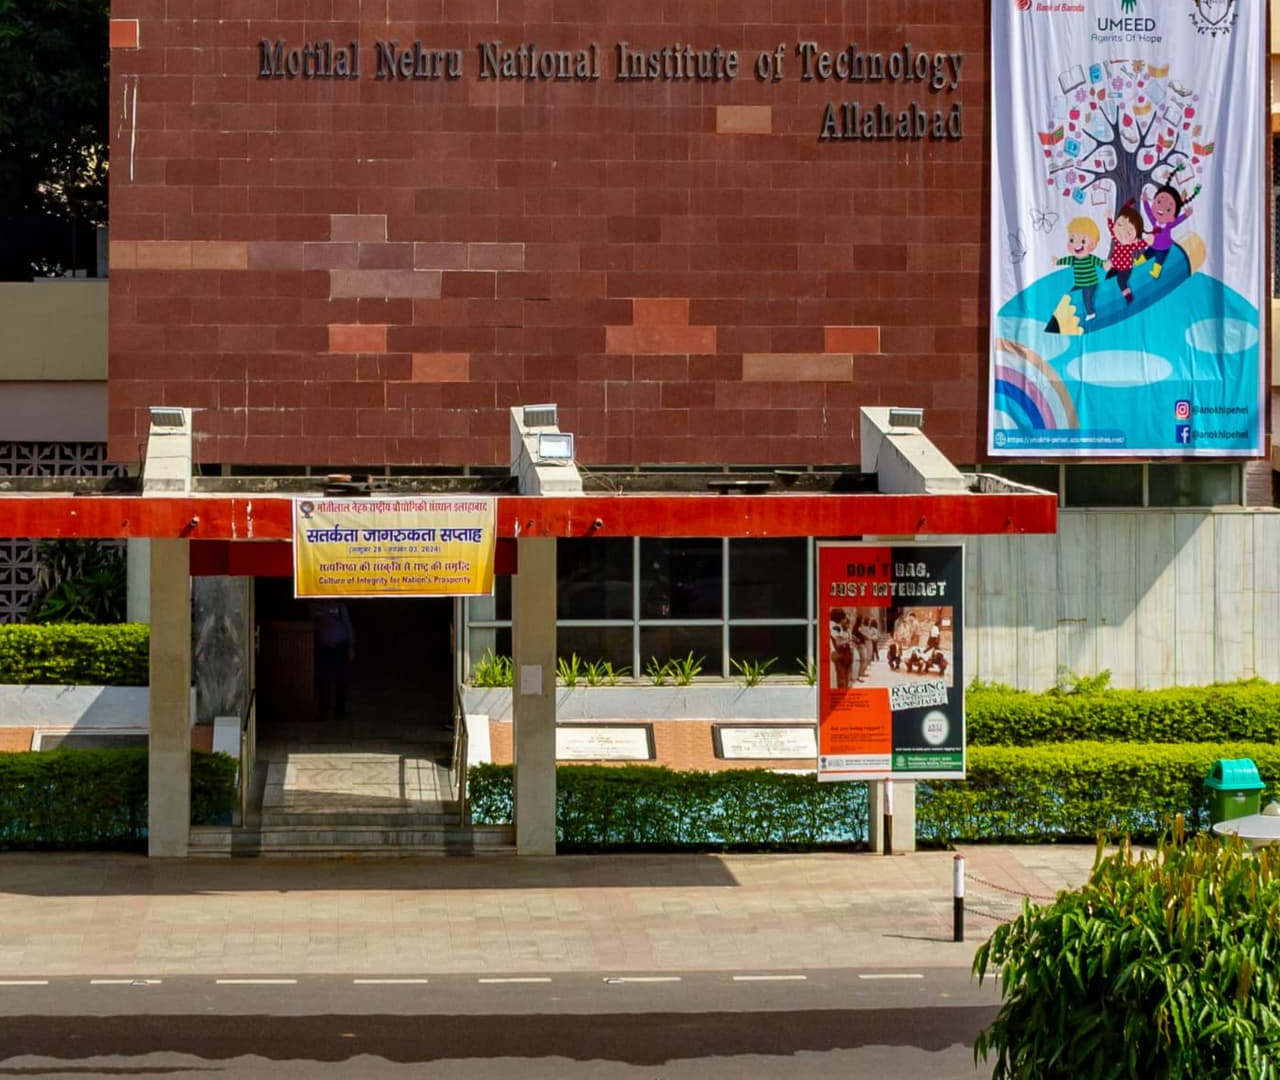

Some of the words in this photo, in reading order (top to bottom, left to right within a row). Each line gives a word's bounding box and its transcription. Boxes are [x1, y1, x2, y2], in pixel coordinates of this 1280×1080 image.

[1097, 17, 1156, 32] UMEED
[1091, 34, 1122, 43] Agents
[1138, 34, 1162, 44] Hope
[257, 39, 360, 80] Motilal
[374, 39, 463, 80] Nehru
[478, 40, 601, 81] National
[615, 41, 739, 82] Institute
[754, 42, 786, 81] of
[796, 41, 963, 91] Technology
[819, 101, 963, 141] Allahabad
[306, 523, 358, 543] सतर्कता
[439, 528, 483, 543] सप्ताह
[360, 561, 370, 571] की
[431, 561, 442, 571] की
[319, 576, 346, 584] Culture
[347, 576, 355, 584] of
[357, 576, 388, 586] Integrity
[390, 576, 400, 584] for
[402, 576, 431, 585] Nation's
[434, 576, 471, 585] Prosperity
[829, 582, 868, 597] JUST
[872, 581, 947, 597] INTERACT
[891, 680, 945, 698] RAGGING
